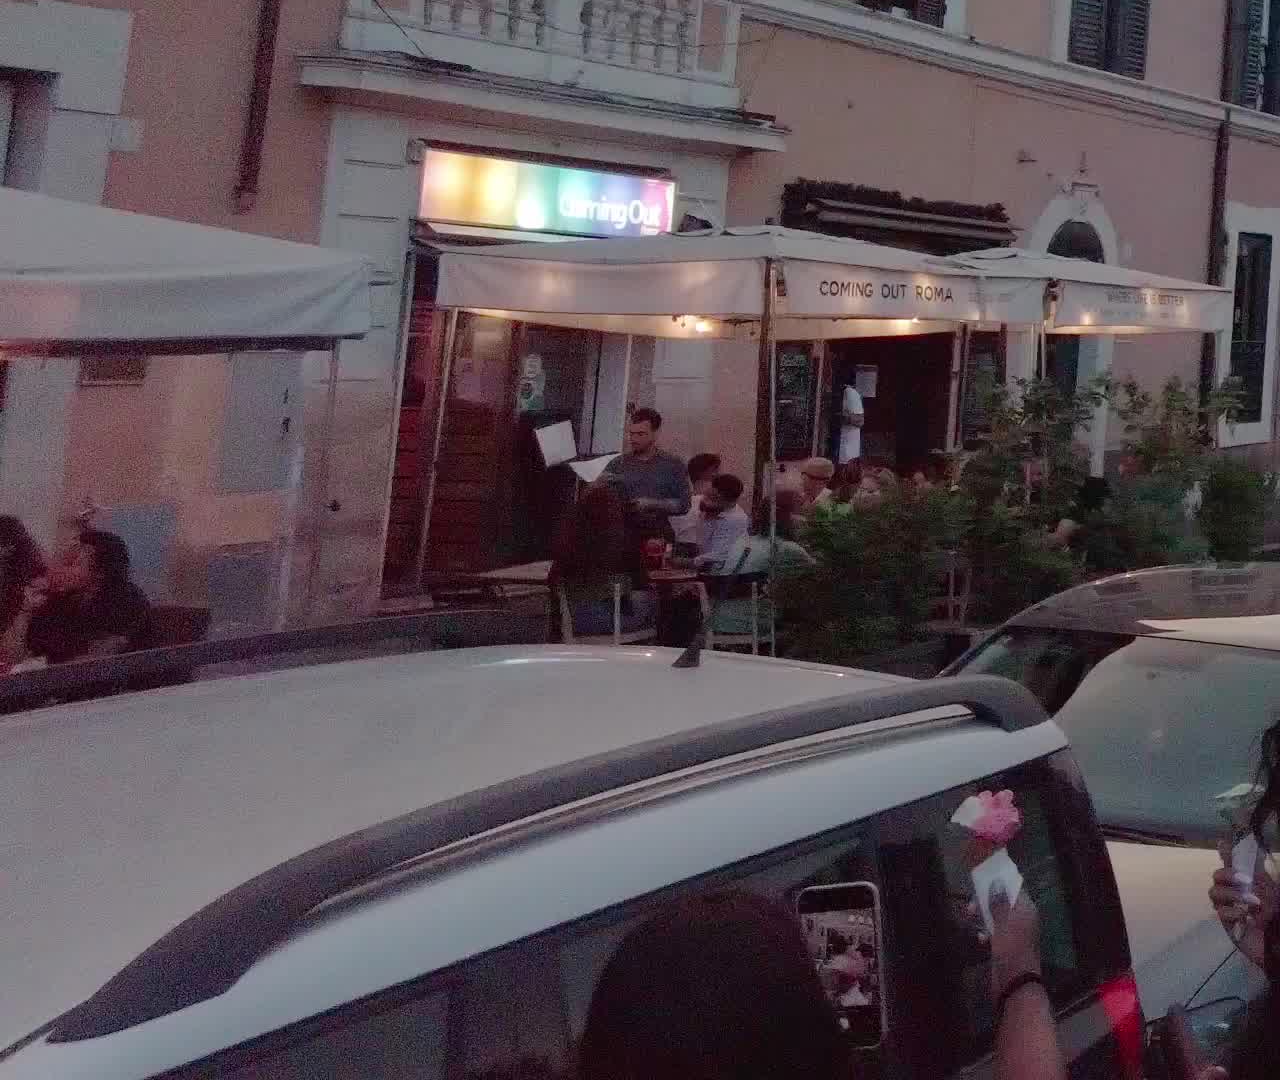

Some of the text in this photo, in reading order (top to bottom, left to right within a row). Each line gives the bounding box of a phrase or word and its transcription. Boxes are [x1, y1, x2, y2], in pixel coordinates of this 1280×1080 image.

[629, 199, 662, 226] Out
[819, 280, 874, 299] COMING
[881, 283, 908, 300] OUT
[915, 285, 954, 303] ROMA
